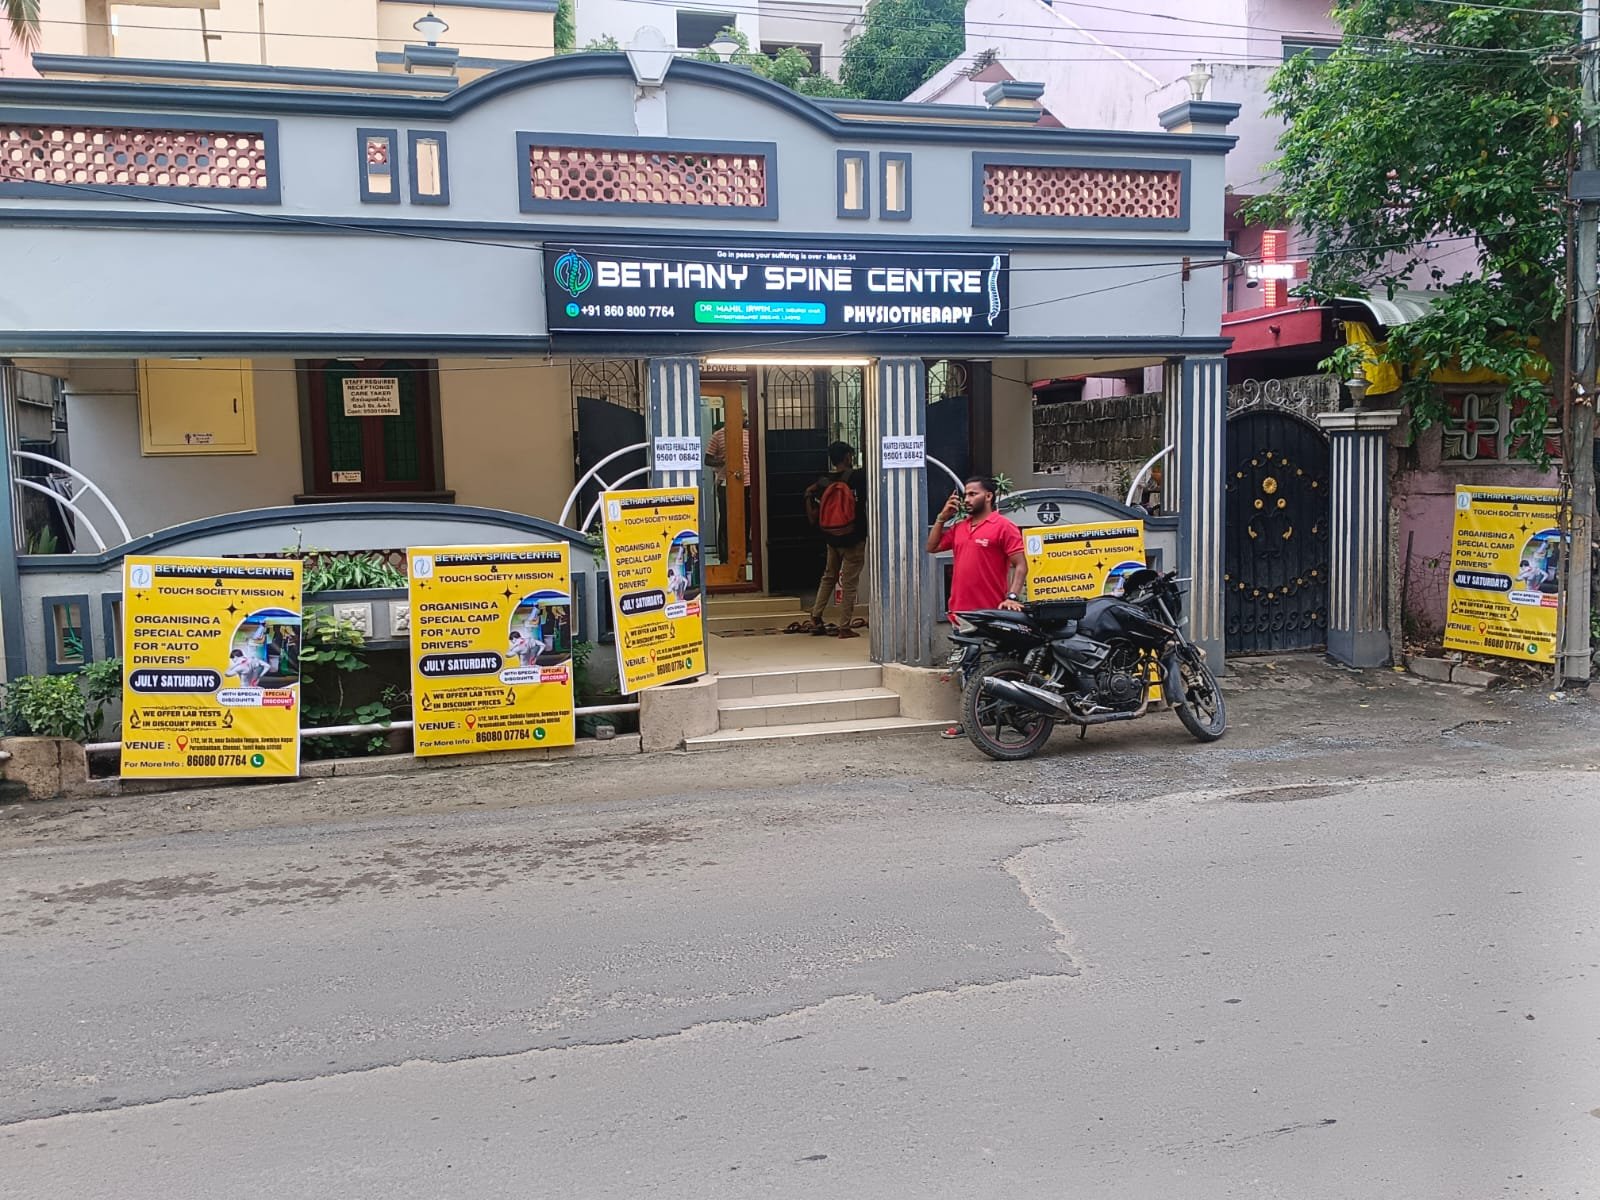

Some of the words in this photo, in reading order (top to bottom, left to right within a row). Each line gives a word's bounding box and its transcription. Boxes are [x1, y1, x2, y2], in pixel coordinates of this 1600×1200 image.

[717, 250, 727, 258] Go
[736, 252, 754, 260] peace
[771, 251, 799, 261] suffering
[801, 252, 806, 260] is
[597, 261, 748, 290] BETHANY
[765, 266, 853, 291] SPINE
[867, 267, 982, 293] CENTRE
[581, 305, 601, 316] +91
[604, 305, 624, 317] 860
[627, 306, 646, 317] 800
[648, 306, 675, 317] 7764
[843, 305, 973, 324] PHYSIOTHERAPY
[656, 443, 673, 451] WANTED
[673, 443, 688, 451] FEMALE
[884, 442, 898, 450] WANTED
[913, 441, 924, 449] STAFF
[656, 453, 677, 461] 95001
[678, 453, 700, 461] 06842
[624, 517, 644, 525] TOUCH
[645, 516, 667, 524] SOCIETY
[1043, 513, 1055, 522] 58
[1043, 532, 1080, 541] BETHANY
[1106, 527, 1138, 535] CENTRE
[1458, 530, 1508, 539] ORGANISING
[615, 542, 656, 553] ORGANISING
[1457, 540, 1488, 548] SPECIAL
[435, 553, 485, 562] BETHANY
[486, 552, 517, 561] SPINE
[520, 551, 560, 559] CENTRE
[1073, 548, 1102, 556] SOCIETY
[616, 556, 642, 566] SPECIAL
[643, 553, 662, 562] CAMP
[155, 564, 210, 574] BETHANY
[211, 566, 245, 575] SPINE
[246, 567, 293, 576] CENTRE
[491, 565, 498, 573] &
[617, 569, 631, 577] FOR
[215, 578, 223, 587] &
[439, 575, 472, 583] TOUCH
[473, 573, 513, 582] SOCIETY
[515, 572, 554, 580] MISSION
[1033, 573, 1087, 584] ORGANISING
[1455, 574, 1471, 585] JULY
[1472, 575, 1508, 588] SATURDAYS
[158, 587, 194, 595] TOUCH
[195, 588, 239, 596] SOCIETY
[241, 589, 284, 597] MISSION
[1034, 586, 1070, 595] SPECIAL
[1071, 584, 1095, 592] CAMP
[420, 602, 488, 611] ORGANISING
[491, 601, 498, 609] A
[622, 597, 635, 611] JULY
[635, 594, 663, 609] SATURDAYS
[134, 615, 210, 624] ORGANISING
[212, 616, 220, 624] A
[420, 615, 465, 624] SPECIAL
[467, 614, 500, 622] CAMP
[420, 629, 443, 637] FOR
[445, 627, 480, 636] "AUTO
[1447, 623, 1472, 631] VENUE
[134, 628, 183, 638] SPECIAL
[186, 629, 221, 638] CAMP
[133, 642, 158, 650] FOR
[161, 642, 199, 651] "AUTO
[421, 640, 473, 650] DRIVERS"
[133, 655, 190, 664] DRIVERS"
[424, 660, 446, 672] JULY
[447, 657, 497, 671] SATURDAYS
[625, 656, 646, 667] VENUE
[134, 675, 159, 688] JULY
[160, 675, 215, 688] SATURDAYS
[446, 691, 468, 699] OFFER
[442, 701, 476, 709] DISCOUNT
[419, 721, 456, 730] VENUE
[476, 731, 502, 743] 86080
[505, 729, 530, 741] 07764
[125, 741, 165, 750] VENUE
[187, 755, 216, 766] 86080
[218, 755, 247, 766] 07764
